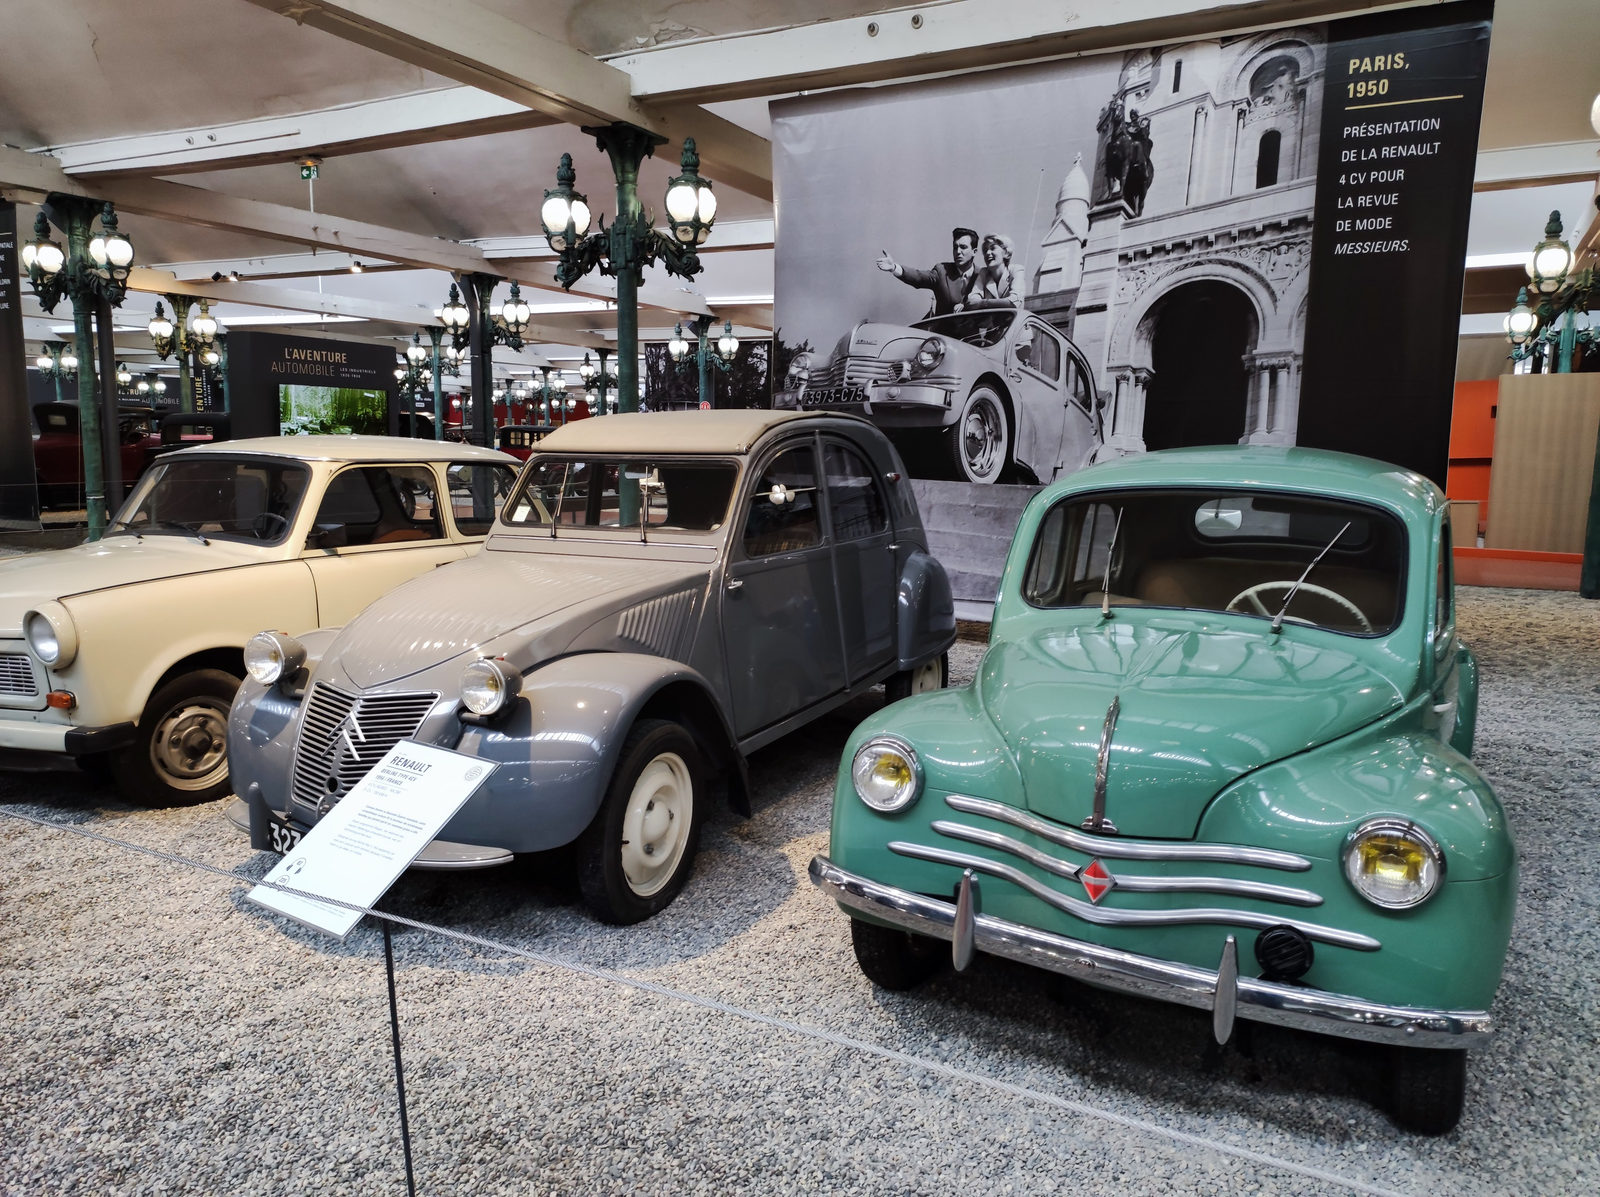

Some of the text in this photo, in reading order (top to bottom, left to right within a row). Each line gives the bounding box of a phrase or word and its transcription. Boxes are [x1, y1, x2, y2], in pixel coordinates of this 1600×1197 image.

[1348, 52, 1409, 75] PARIS,
[1346, 78, 1389, 98] 1950
[1343, 118, 1441, 138] PRÉSENTATION
[1341, 142, 1441, 162] DE LA RENAULT
[1339, 169, 1405, 185] 4 CV POUR
[1337, 193, 1399, 209] LA REVUE
[1335, 217, 1393, 232] DE MODE
[1334, 239, 1411, 255] MESSIEURS.
[285, 347, 348, 364] L'AVENTURE
[271, 361, 336, 377] AUTOMOBILE
[195, 376, 204, 413] ENTURE
[390, 756, 433, 773] RENAULT
